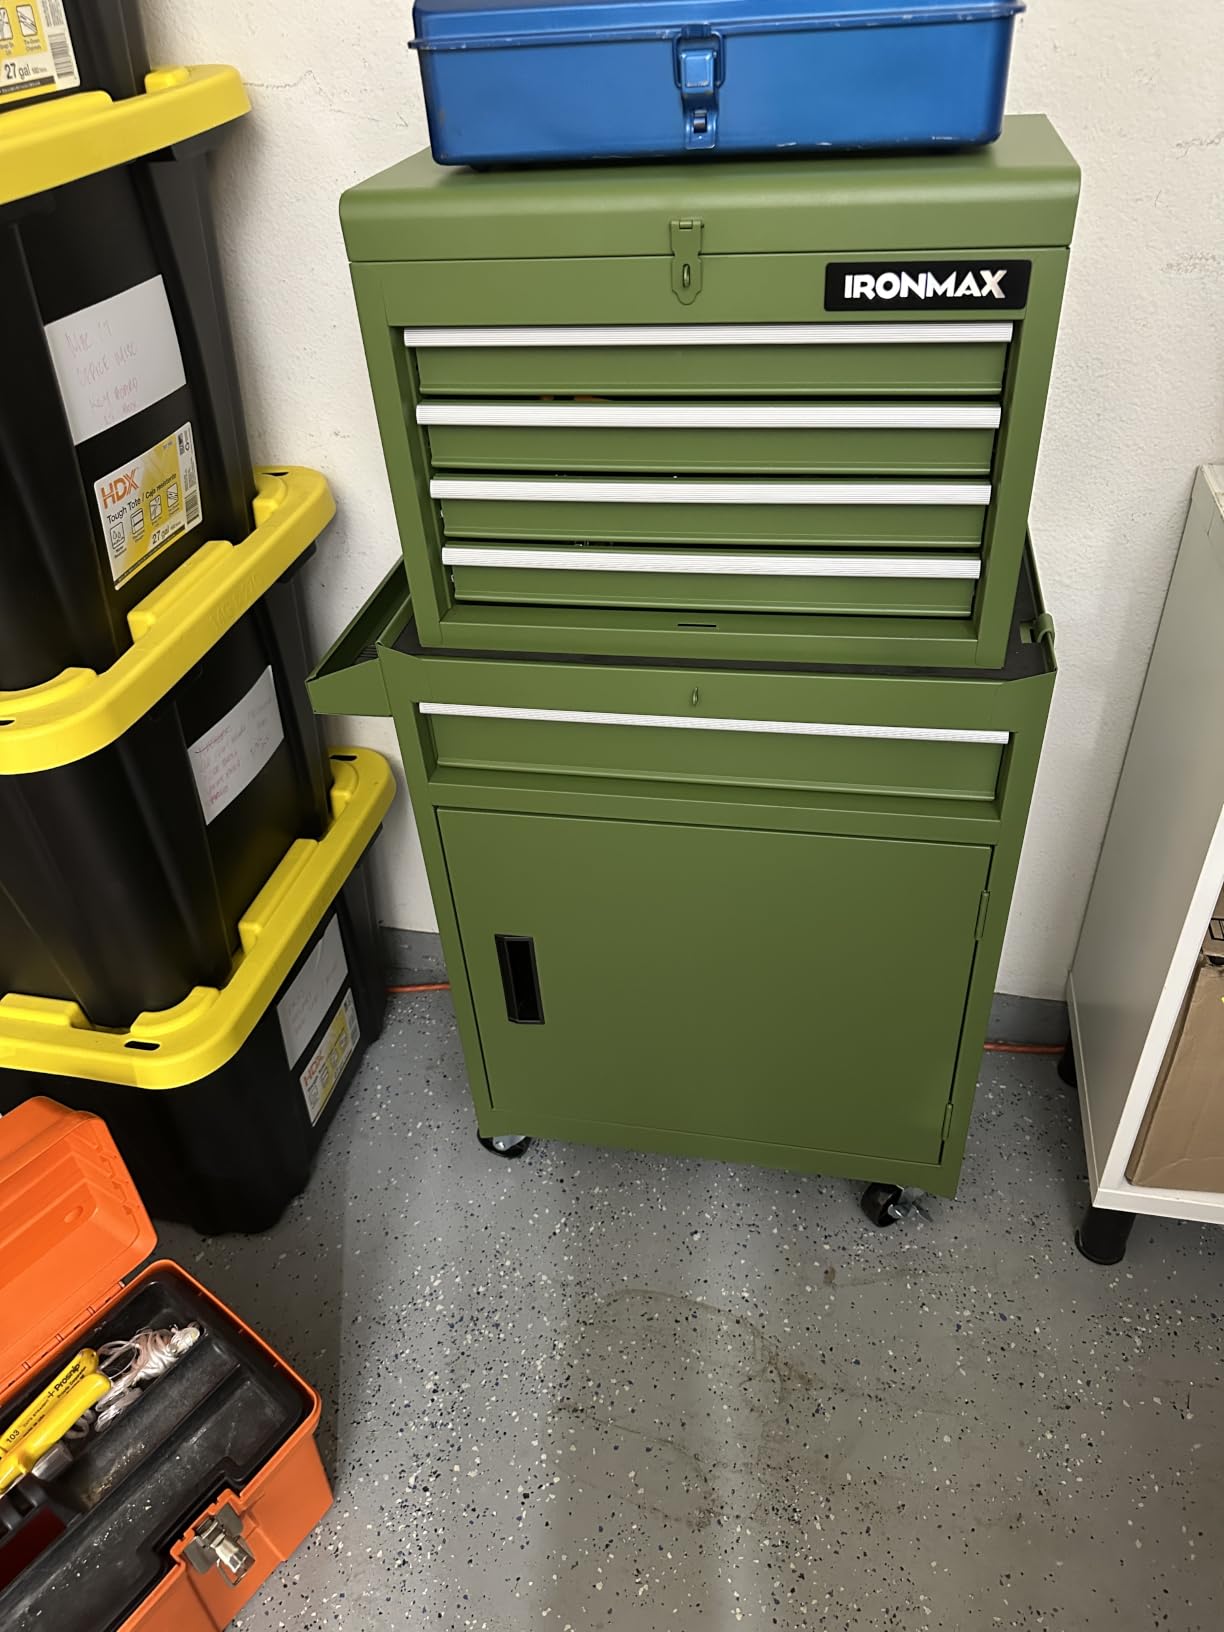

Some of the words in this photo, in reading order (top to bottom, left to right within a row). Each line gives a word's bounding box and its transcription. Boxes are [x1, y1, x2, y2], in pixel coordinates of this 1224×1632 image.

[4, 62, 17, 80] 27
[18, 63, 31, 80] gal
[843, 269, 1007, 300] IRONMAX
[100, 467, 140, 510] HDX
[106, 504, 128, 525] Tough
[127, 497, 141, 512] Tote
[151, 528, 161, 545] 27
[160, 523, 171, 540] gal
[54, 1363, 80, 1392] Prosnip
[6, 1428, 20, 1444] 103
